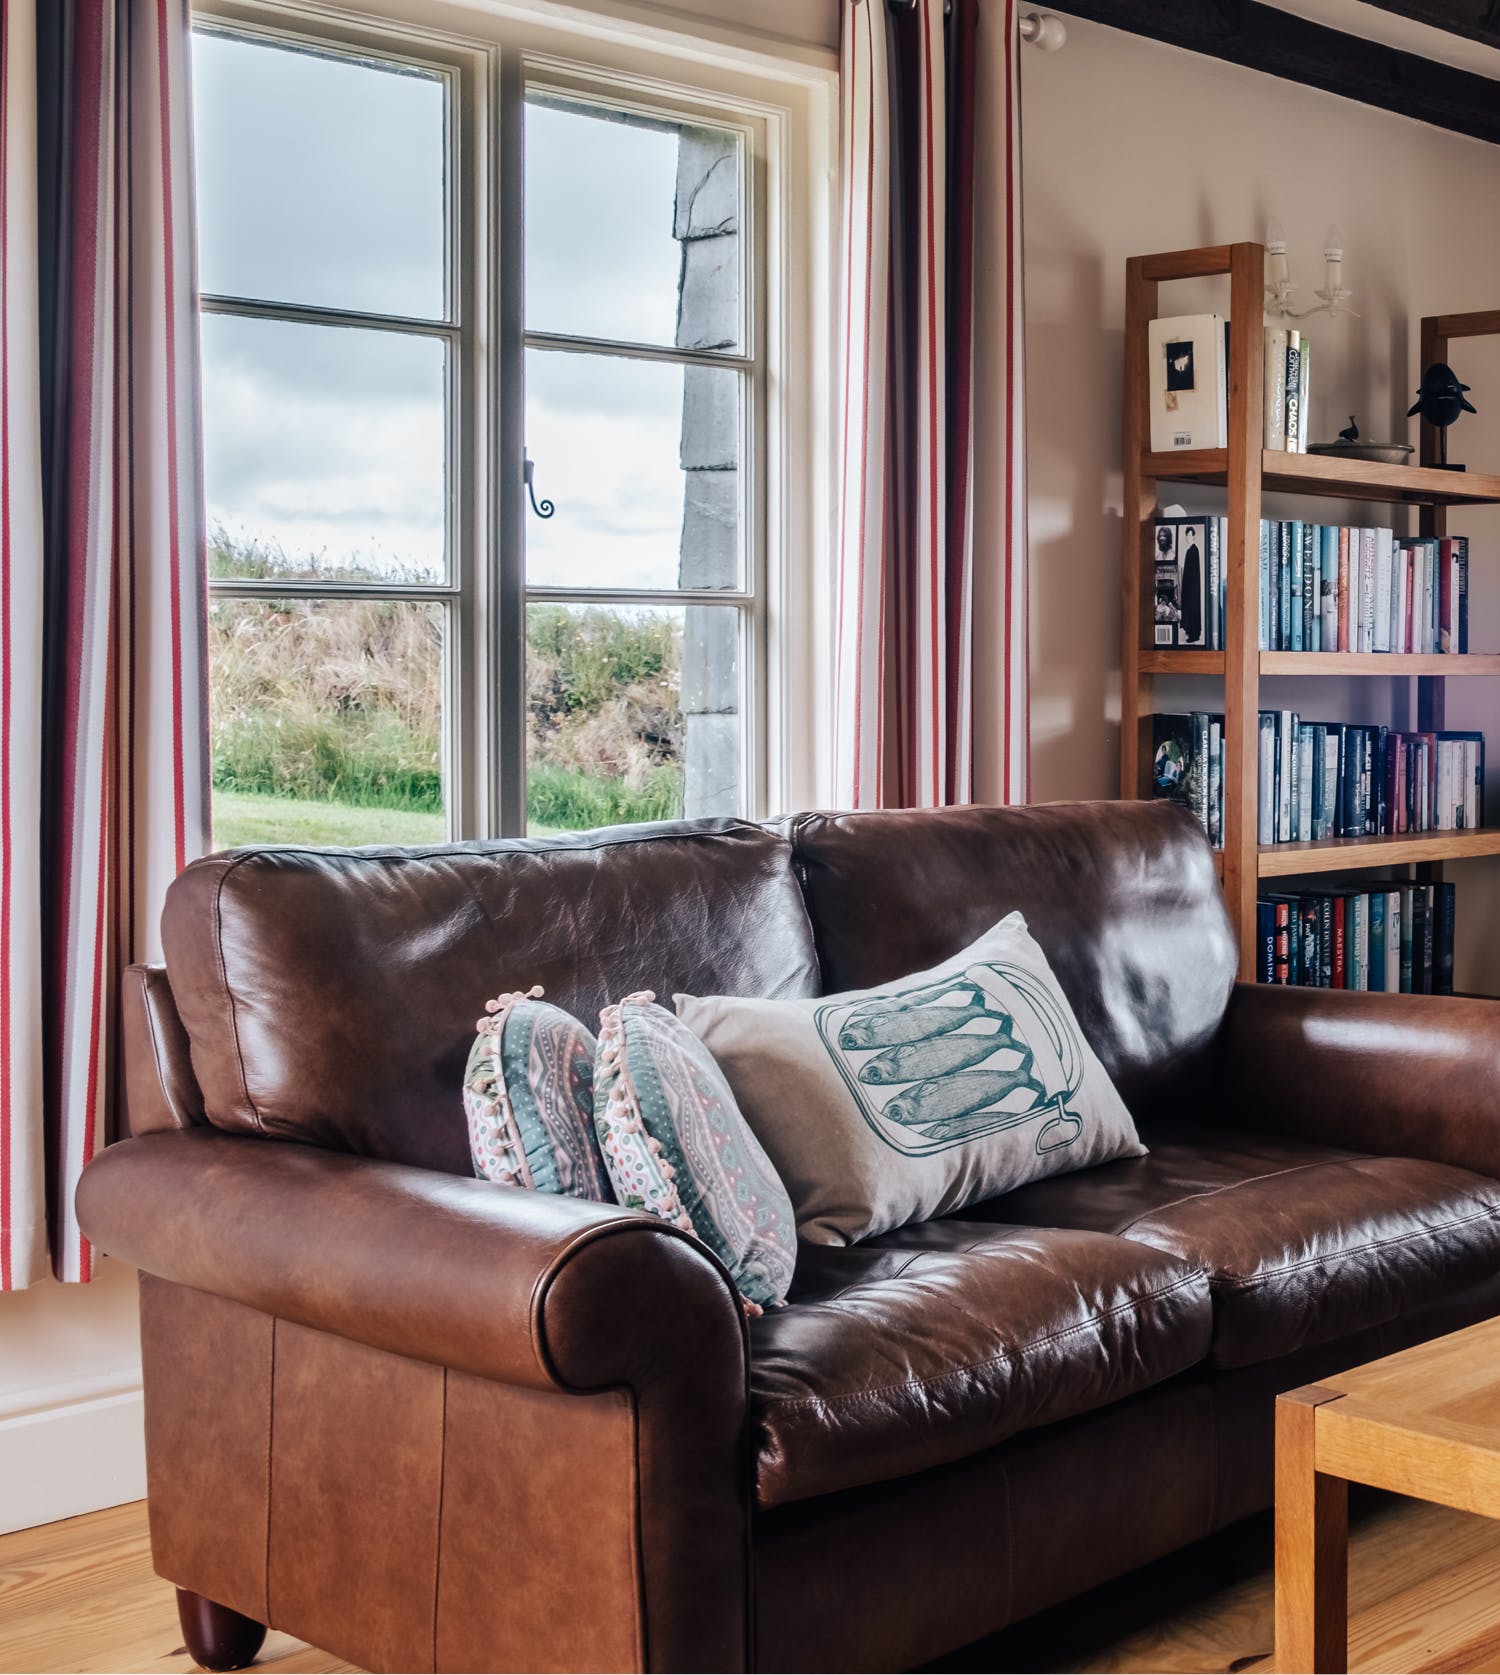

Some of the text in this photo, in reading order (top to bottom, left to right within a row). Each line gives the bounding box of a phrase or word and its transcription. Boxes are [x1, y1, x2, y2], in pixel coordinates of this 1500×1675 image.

[1288, 398, 1297, 436] CHAOS
[1210, 525, 1218, 552] TOM
[1304, 535, 1312, 609] WELDON
[1323, 902, 1331, 964] COLIN DEXTER
[1336, 927, 1344, 973] MAESTRA
[1266, 936, 1274, 984] DOMINA
